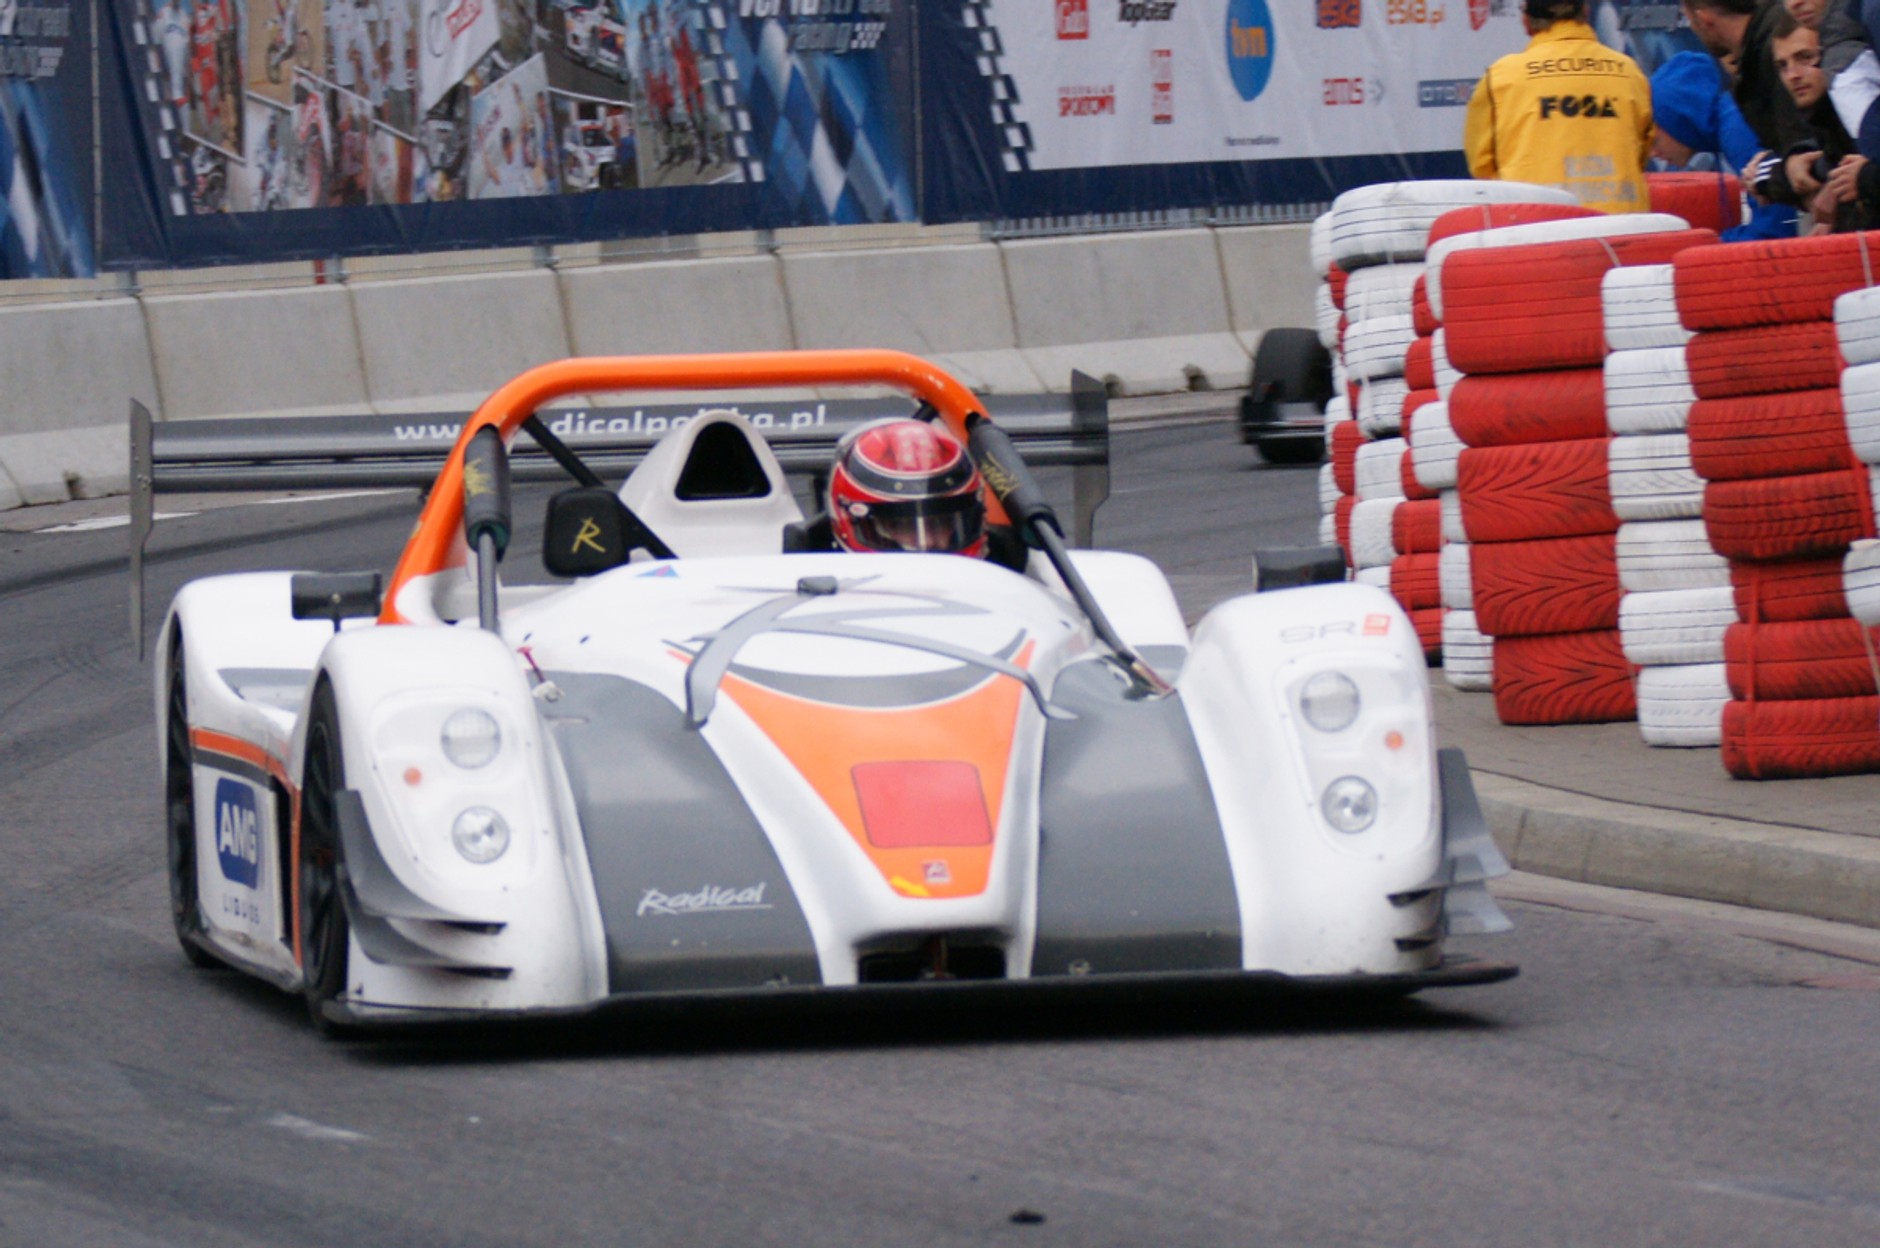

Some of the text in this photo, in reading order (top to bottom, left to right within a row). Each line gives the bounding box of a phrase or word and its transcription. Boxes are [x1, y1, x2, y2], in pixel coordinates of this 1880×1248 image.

[1526, 57, 1625, 75] SECURITY
[1538, 95, 1619, 119] FOSA
[572, 517, 607, 554] R
[219, 801, 258, 865] AMG
[636, 881, 774, 917] Radical
